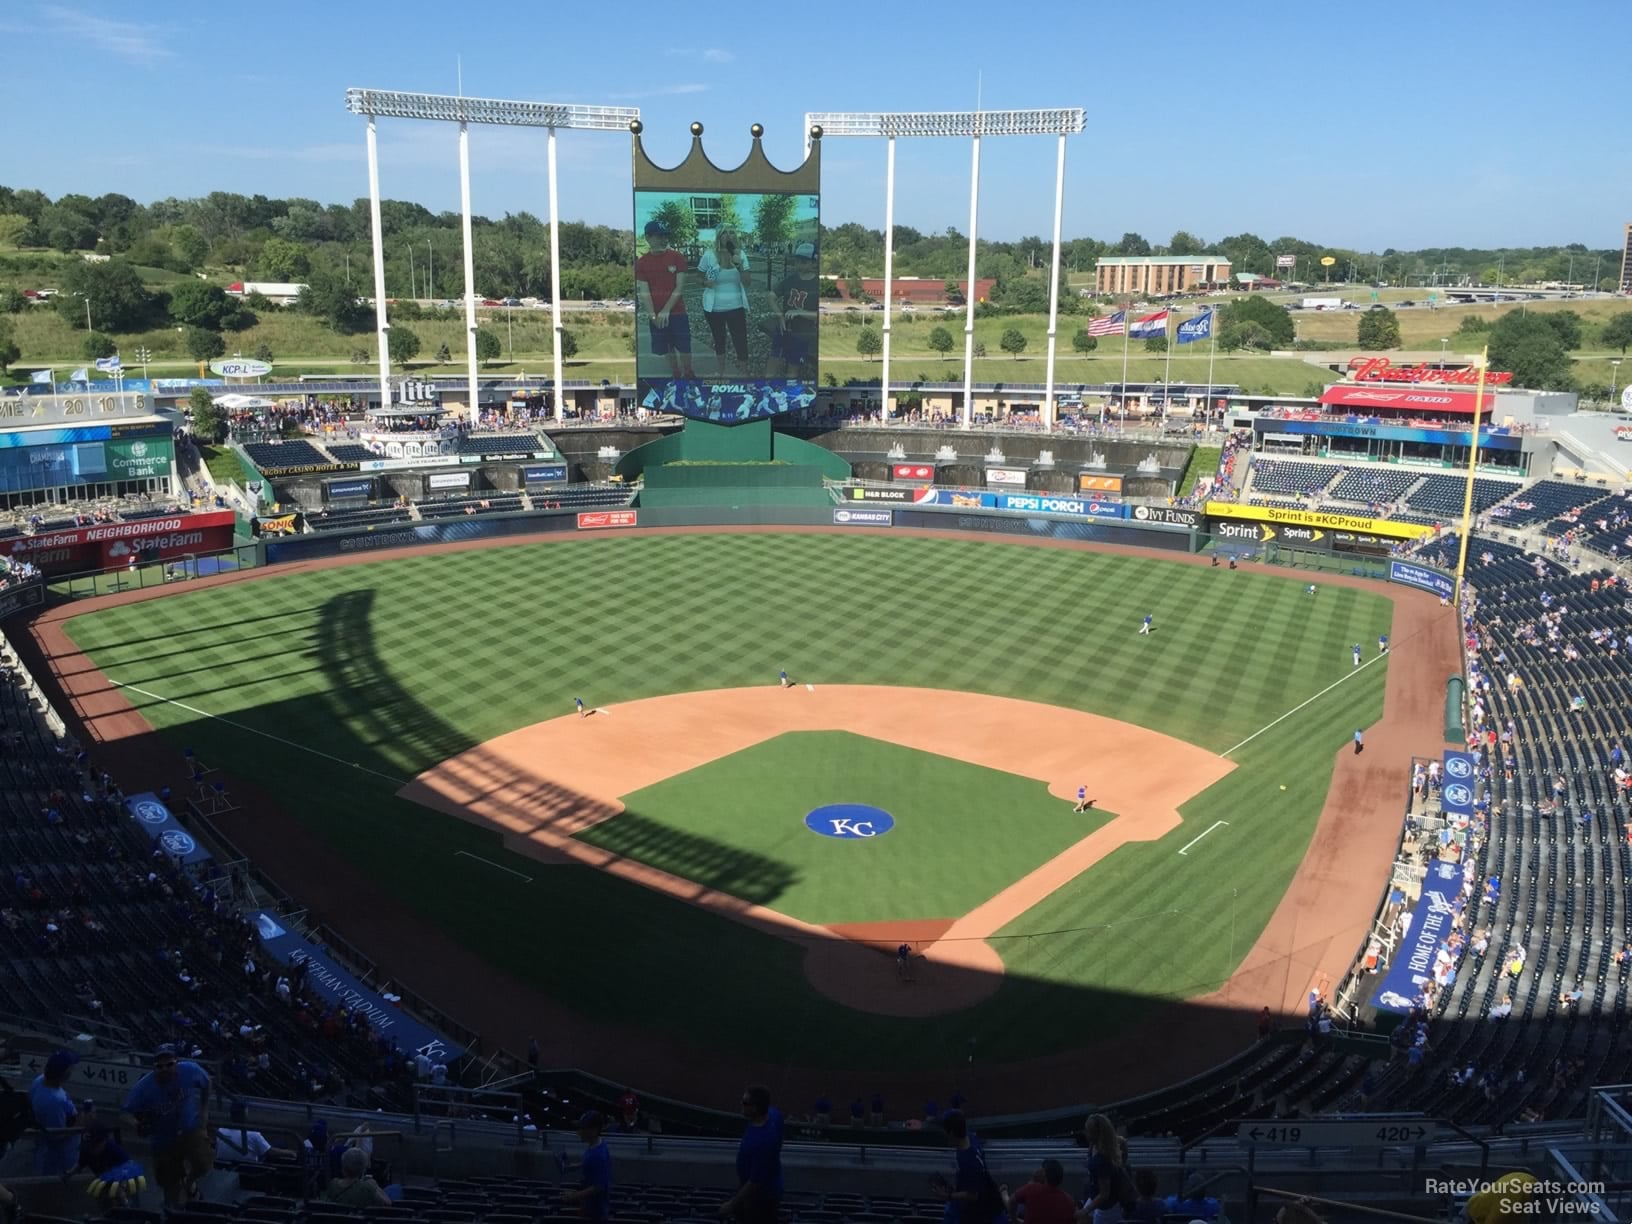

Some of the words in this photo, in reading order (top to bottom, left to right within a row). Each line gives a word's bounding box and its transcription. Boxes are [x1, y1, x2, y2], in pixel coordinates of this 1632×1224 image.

[399, 381, 435, 405] Lite
[711, 384, 746, 393] ROYAL
[64, 399, 84, 415] 20
[100, 397, 116, 413] 10
[136, 394, 145, 409] 5
[112, 455, 168, 469] Commerce
[128, 463, 155, 476] Bank
[1007, 497, 1039, 510] PEPSI
[1041, 501, 1084, 513] PORCH
[262, 519, 294, 530] SONIC
[1268, 509, 1302, 523] Sprint
[1305, 513, 1313, 522] is
[1315, 514, 1373, 529] #KCProud
[86, 519, 181, 541] NEIGHBORHOOD
[1219, 522, 1258, 540] Sprint
[1284, 527, 1311, 540] Sprint
[340, 531, 417, 549] COUNTDOWN
[829, 818, 876, 837] KC
[1424, 912, 1444, 931] THE
[1419, 930, 1438, 945] OF
[1408, 942, 1434, 973] HOME
[337, 988, 396, 1029] STADIUM
[99, 1068, 128, 1084] 418
[1266, 1127, 1301, 1142] 419
[1376, 1127, 1410, 1142] 420
